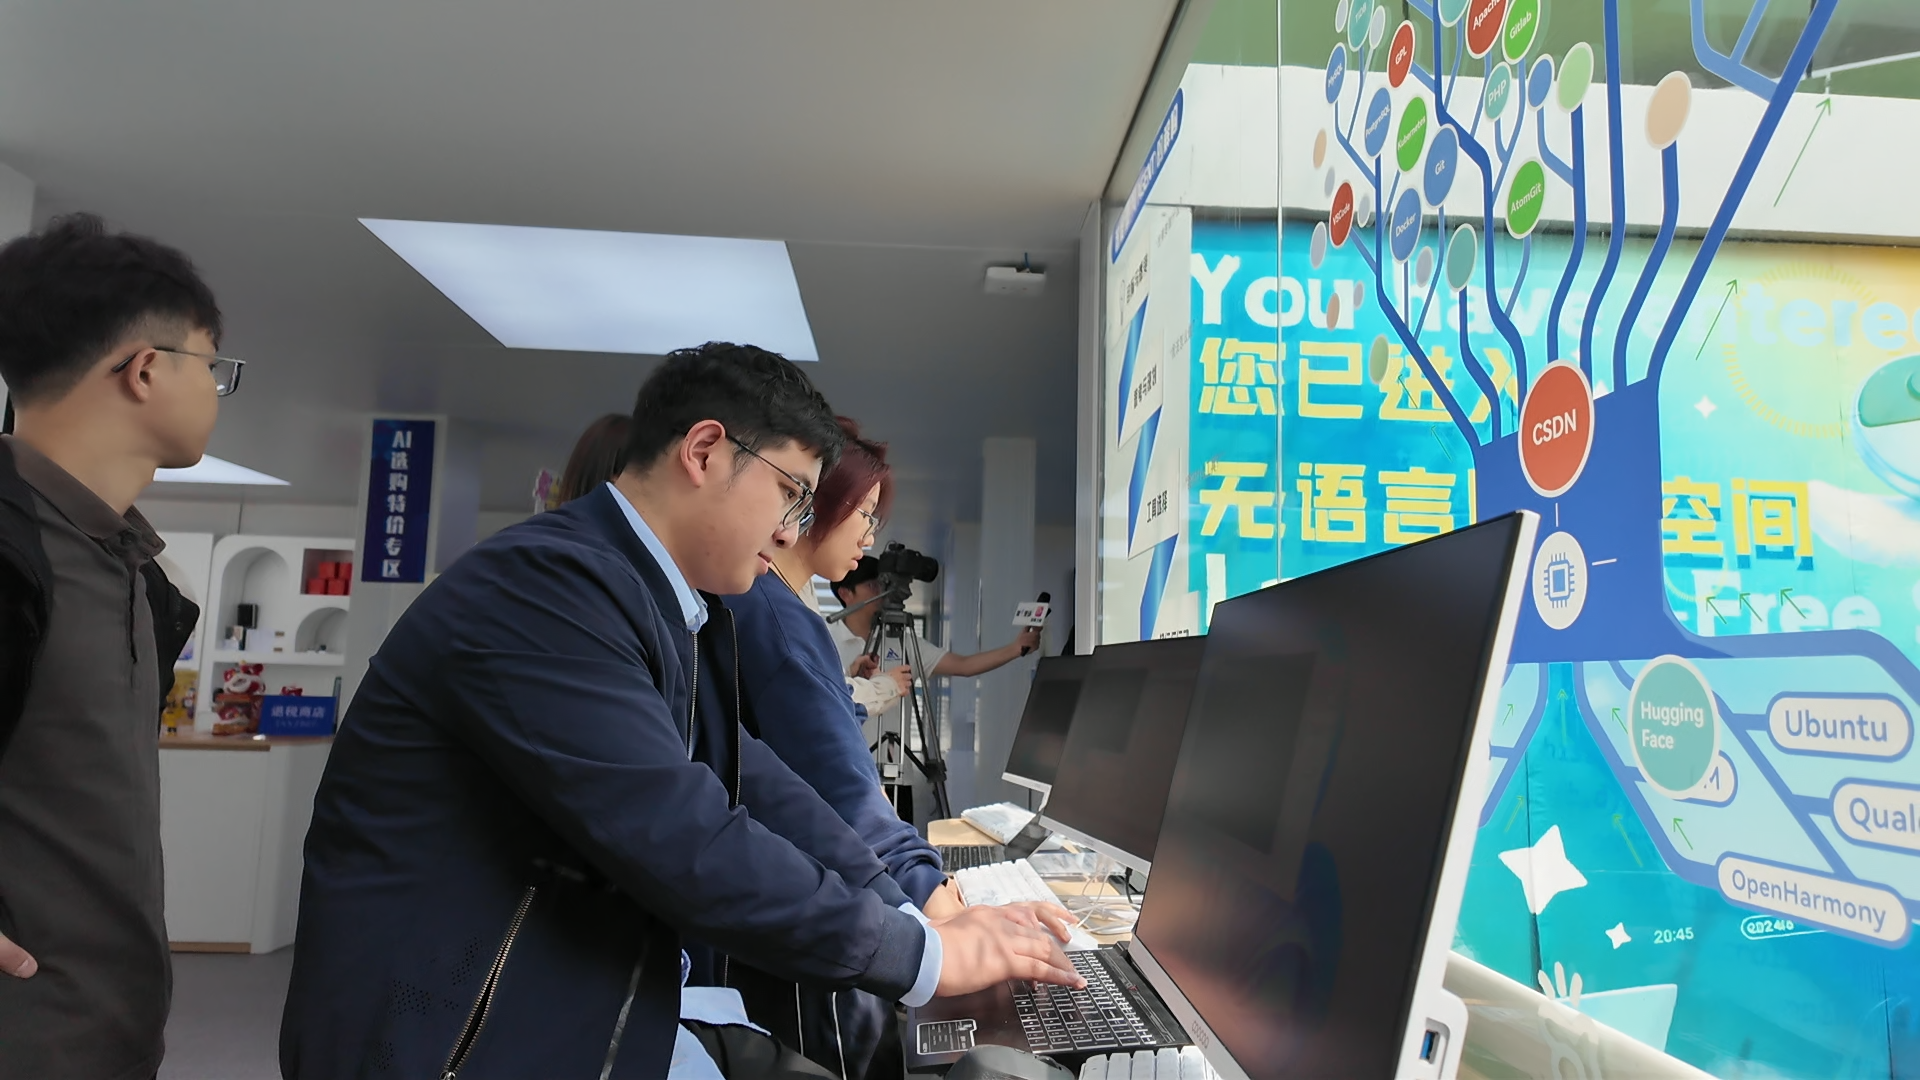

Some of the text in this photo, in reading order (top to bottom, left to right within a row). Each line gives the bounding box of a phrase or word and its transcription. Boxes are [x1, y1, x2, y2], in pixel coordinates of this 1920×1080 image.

[1509, 11, 1532, 40] Gitlab
[1395, 46, 1408, 65] GPL
[1488, 79, 1507, 107] PHP
[1397, 116, 1427, 149] Kubernetes
[1435, 160, 1446, 175] Git
[1510, 182, 1542, 215] AtomGit
[1395, 212, 1417, 237] Docker
[1190, 252, 1355, 330] You
[1637, 282, 1920, 350] entere
[1531, 409, 1578, 445] CSDN
[1641, 702, 1704, 727] Hugging
[1785, 710, 1888, 742] Ubuntu
[1642, 729, 1674, 750] Face
[1849, 797, 1920, 834] Qual
[1731, 869, 1887, 932] OpenHarmony
[1653, 927, 1694, 944] 20:45
